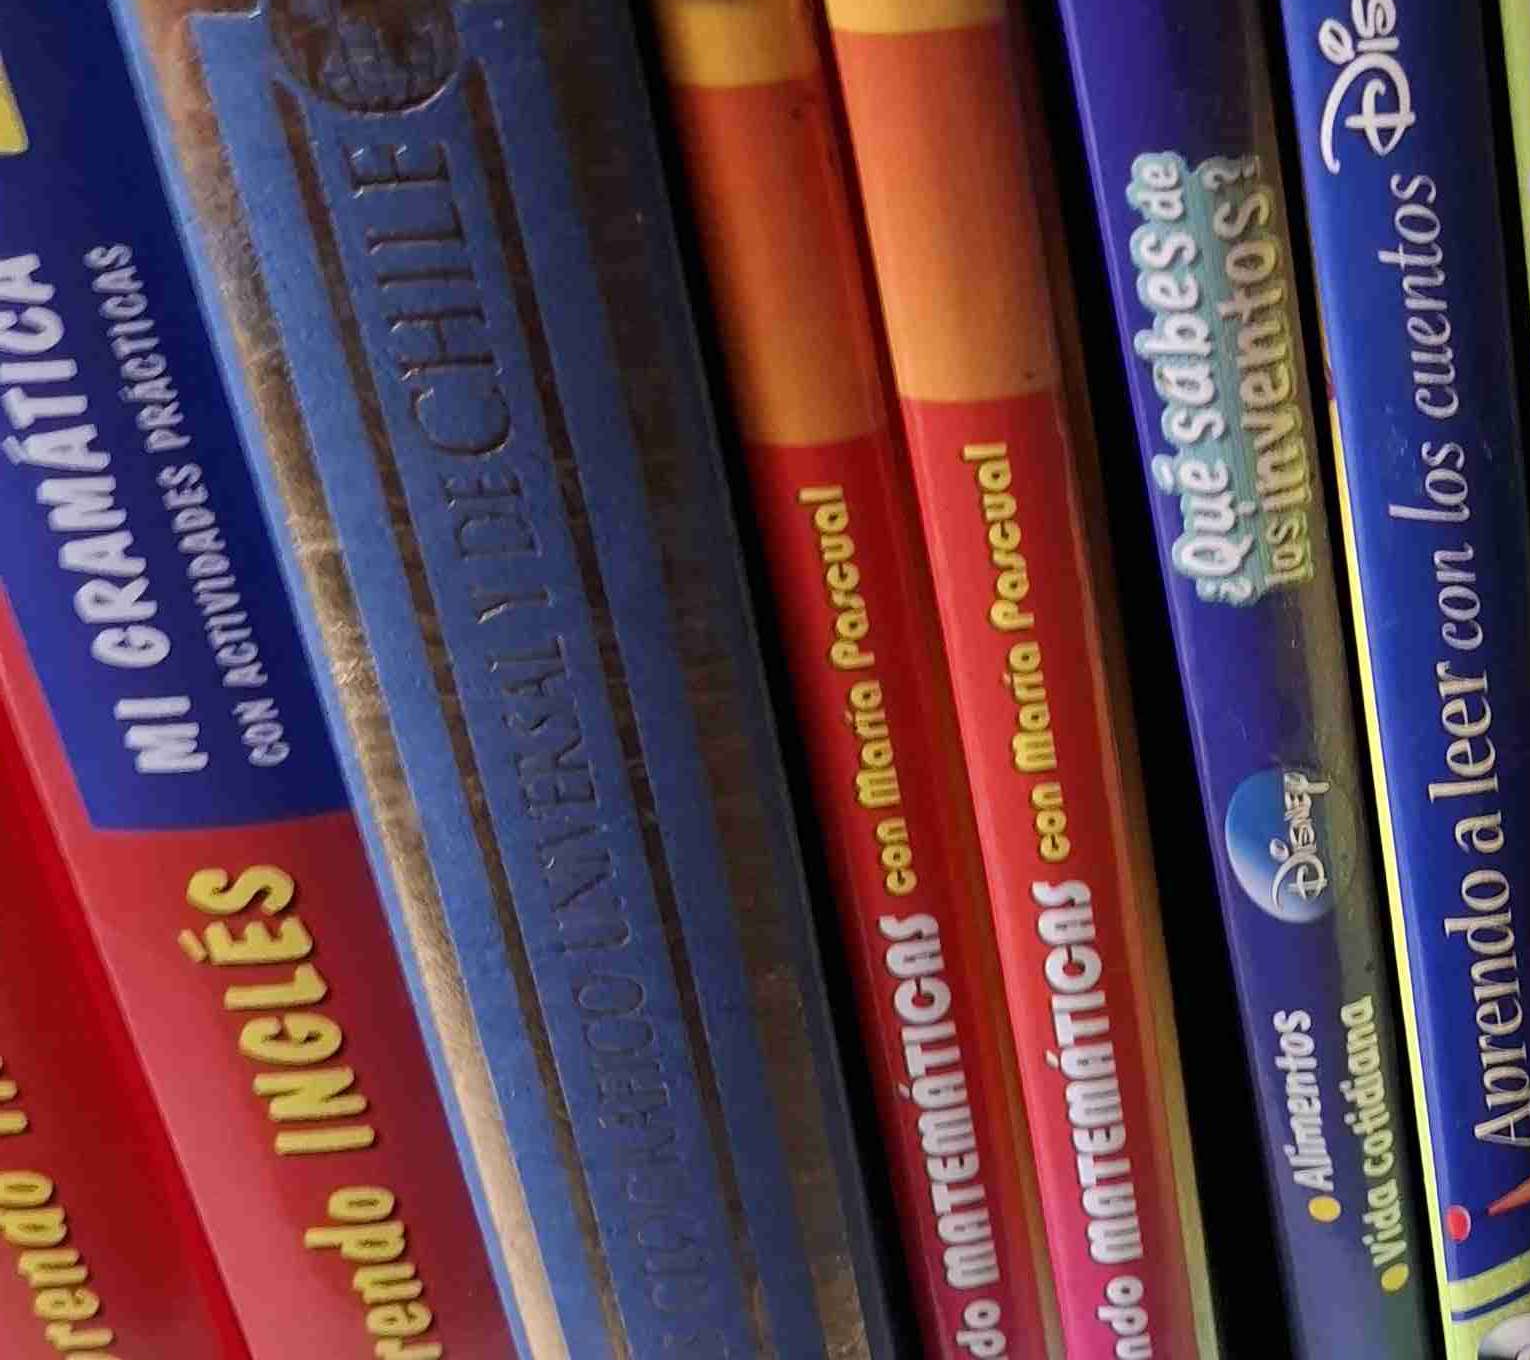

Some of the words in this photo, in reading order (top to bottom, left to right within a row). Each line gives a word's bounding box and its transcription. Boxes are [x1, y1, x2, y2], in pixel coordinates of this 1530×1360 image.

[1129, 154, 1184, 220] de
[84, 243, 192, 454] PRÁCTICAS
[341, 139, 513, 459] CHILE
[1138, 233, 1226, 438] sabes
[1379, 173, 1460, 420] cuentos
[0, 252, 171, 669] GRAMÁTICA
[440, 469, 545, 561] DE
[962, 442, 1036, 632] Pascual
[1154, 454, 1254, 606] ¿Qué
[1389, 440, 1470, 524] los
[156, 462, 268, 688] ACTIVIDADES
[799, 485, 876, 671] Pascual
[1266, 510, 1313, 587] los
[1431, 542, 1484, 651] con
[113, 695, 209, 775] MI
[232, 697, 290, 768] CON
[1428, 660, 1499, 804] leer
[876, 816, 916, 896] con
[1032, 780, 1072, 864] con
[1454, 811, 1506, 855] a
[176, 863, 377, 1158] INGLÉS
[1032, 878, 1144, 1265] MATEMÁTICAS
[1341, 997, 1397, 1180] cotidiana
[878, 909, 1000, 1290] MATEMÁTICAS
[1274, 1010, 1334, 1193] Alimentos
[1364, 1190, 1408, 1269] Vida
